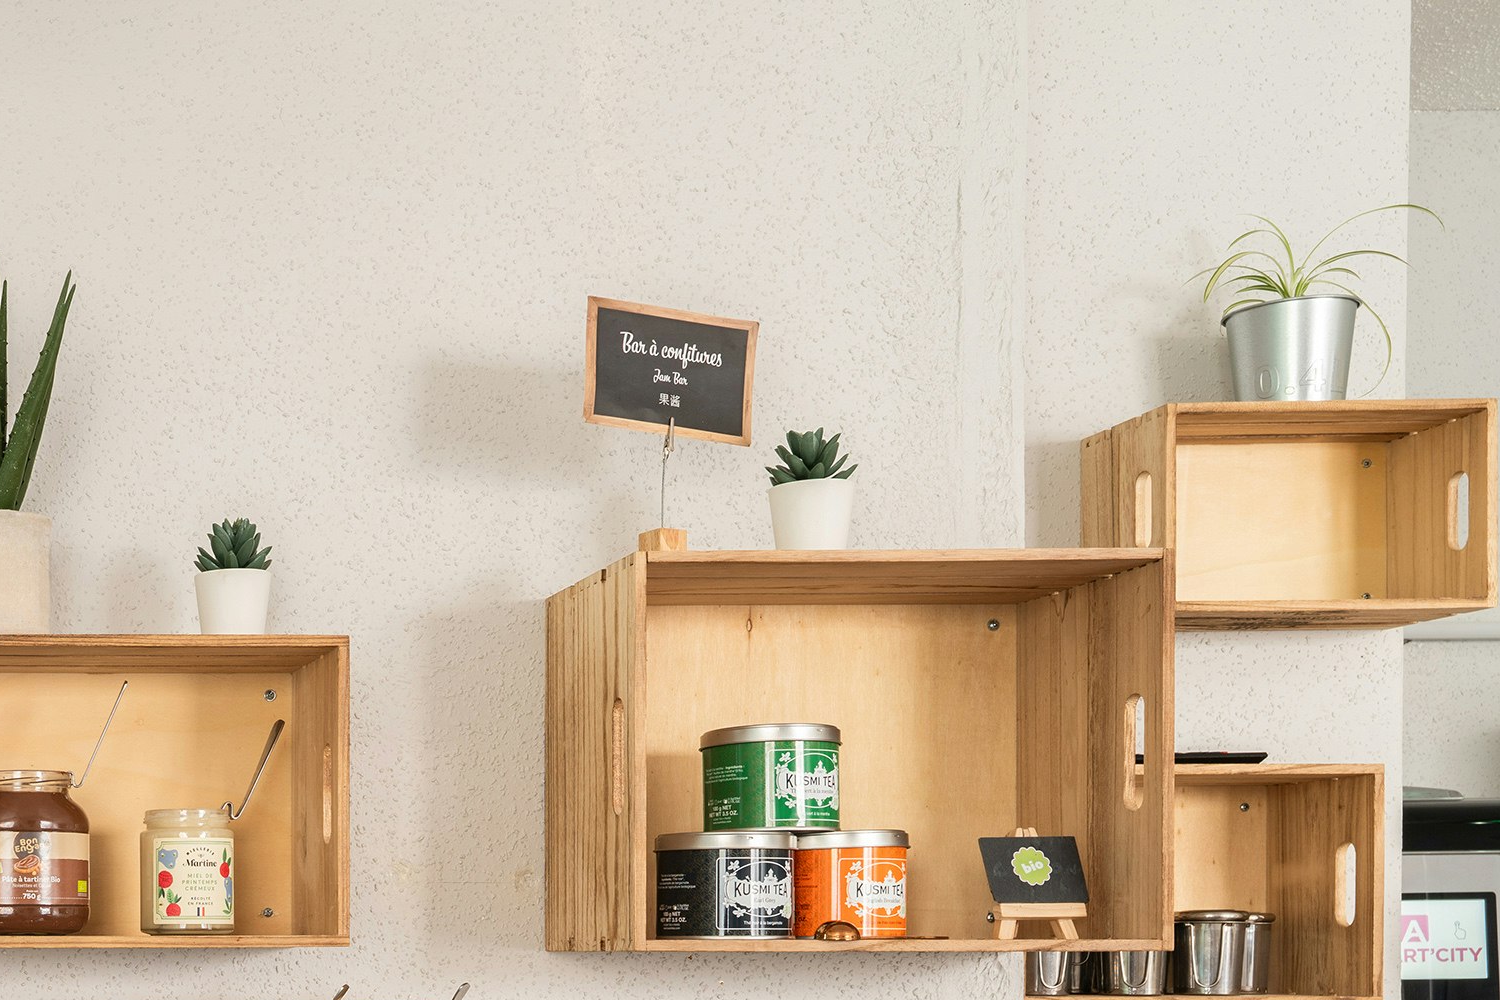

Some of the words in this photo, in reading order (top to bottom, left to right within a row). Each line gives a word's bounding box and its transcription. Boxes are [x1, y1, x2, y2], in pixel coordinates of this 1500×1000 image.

[620, 331, 647, 354] Bar
[650, 339, 659, 357] à
[661, 343, 722, 369] confitures
[653, 369, 671, 384] Jam
[672, 371, 688, 386] Bar
[19, 837, 38, 846] Bon
[183, 859, 217, 867] Martine
[1020, 860, 1044, 874] bio
[734, 881, 770, 897] KUSMI
[773, 883, 788, 898] TEA
[1401, 947, 1483, 963] RT'CITY
